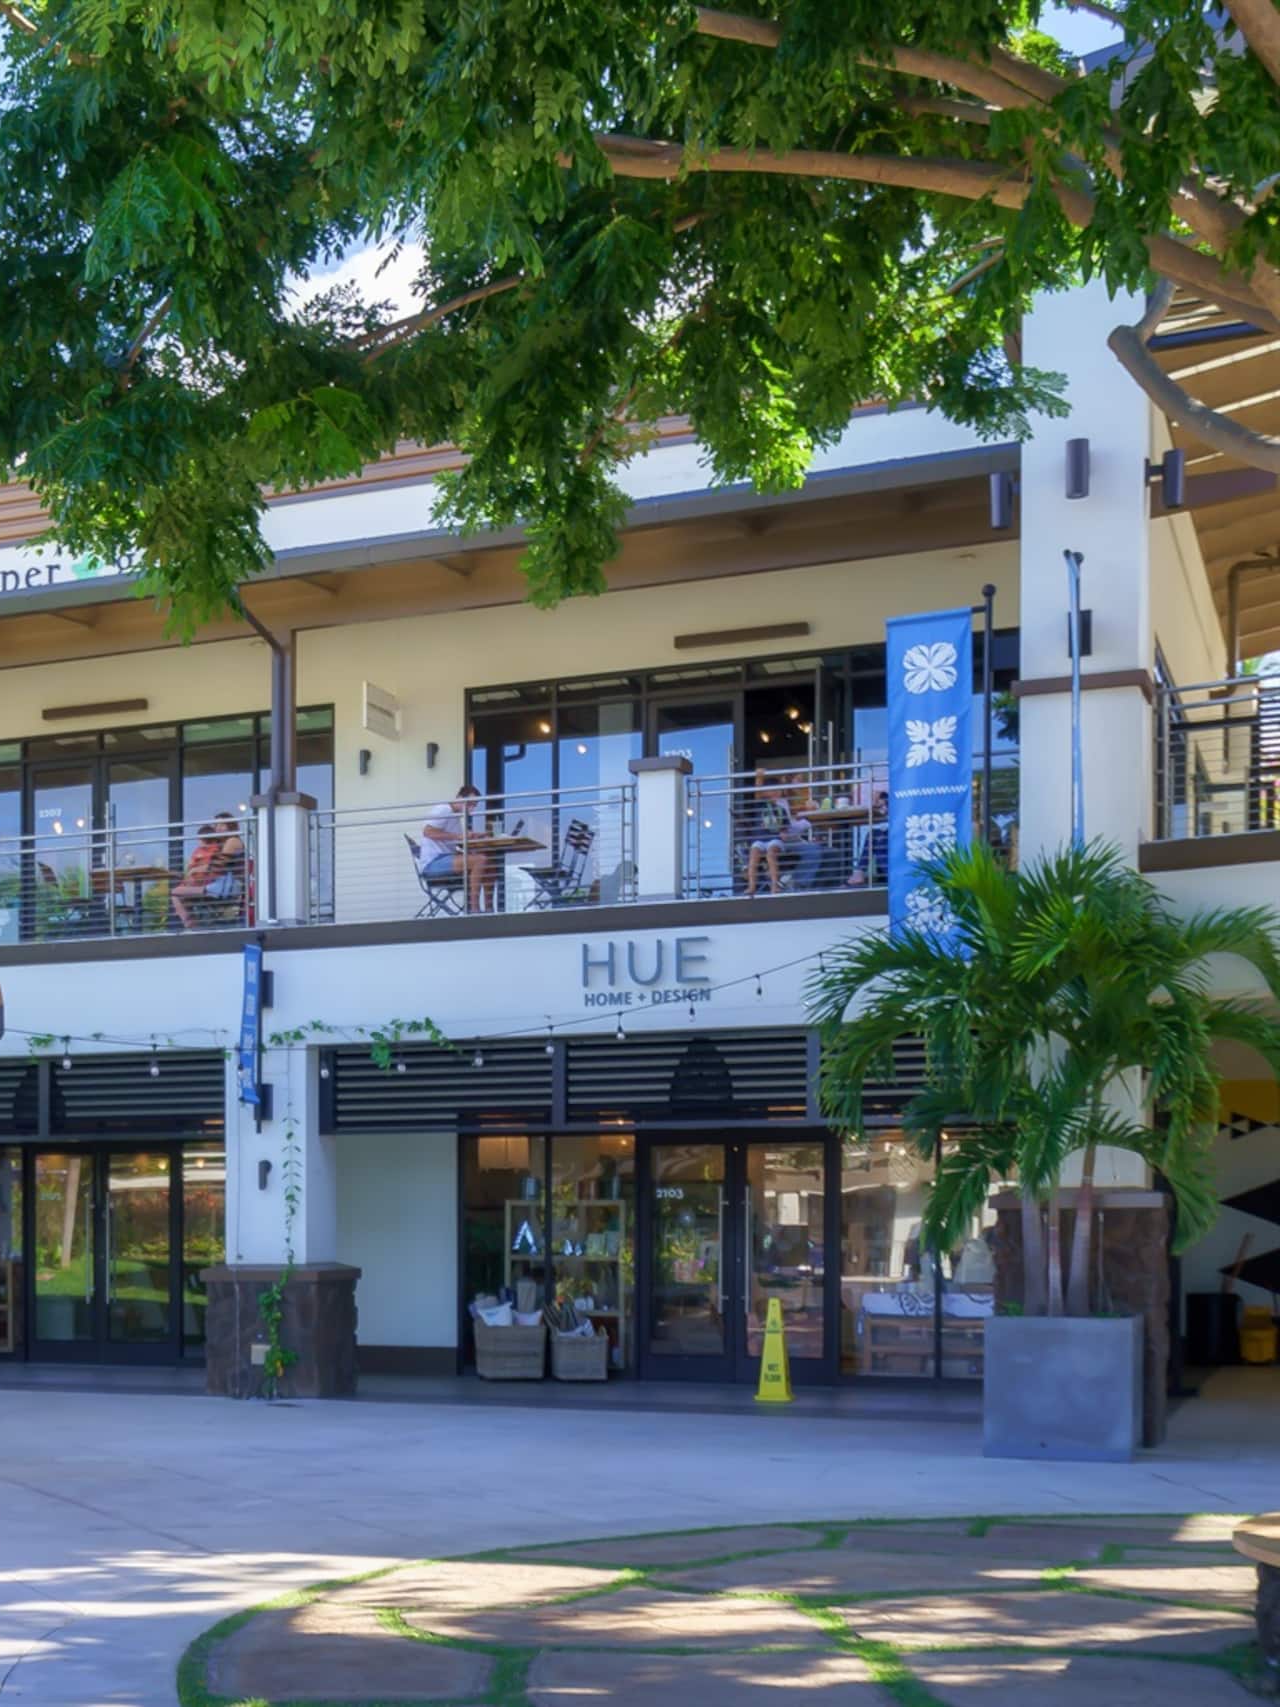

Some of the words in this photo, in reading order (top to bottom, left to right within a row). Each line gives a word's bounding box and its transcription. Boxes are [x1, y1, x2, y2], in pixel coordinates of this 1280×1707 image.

[582, 935, 710, 988] HUE
[584, 991, 632, 1007] HOME
[651, 988, 711, 1005] DESIGN
